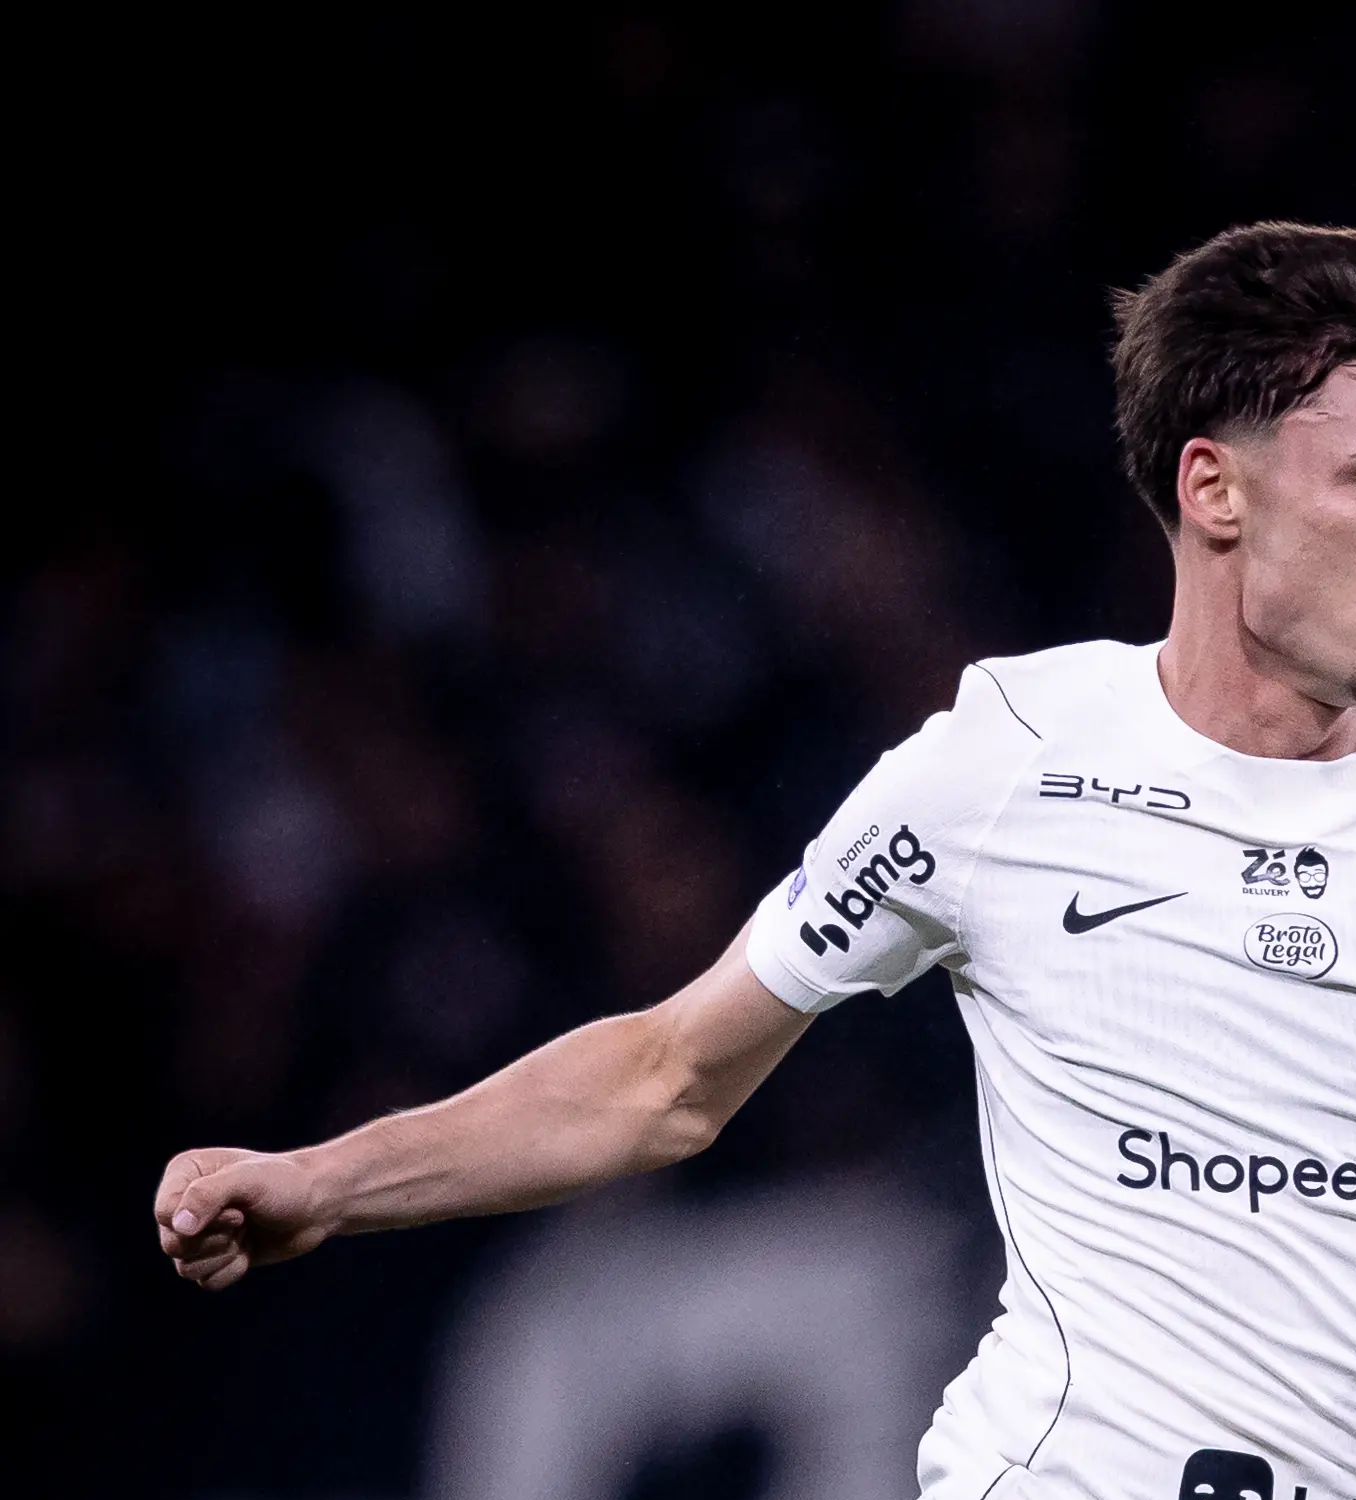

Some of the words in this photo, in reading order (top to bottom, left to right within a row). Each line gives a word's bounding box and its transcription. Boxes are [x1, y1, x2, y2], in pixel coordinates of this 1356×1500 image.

[1039, 773, 1191, 810] BYD
[836, 824, 880, 871] banco
[824, 824, 936, 930] bmg
[1241, 848, 1291, 886] Zé
[1242, 886, 1290, 897] DELIVERY
[1255, 924, 1322, 945] Broto
[1262, 943, 1326, 967] Legal
